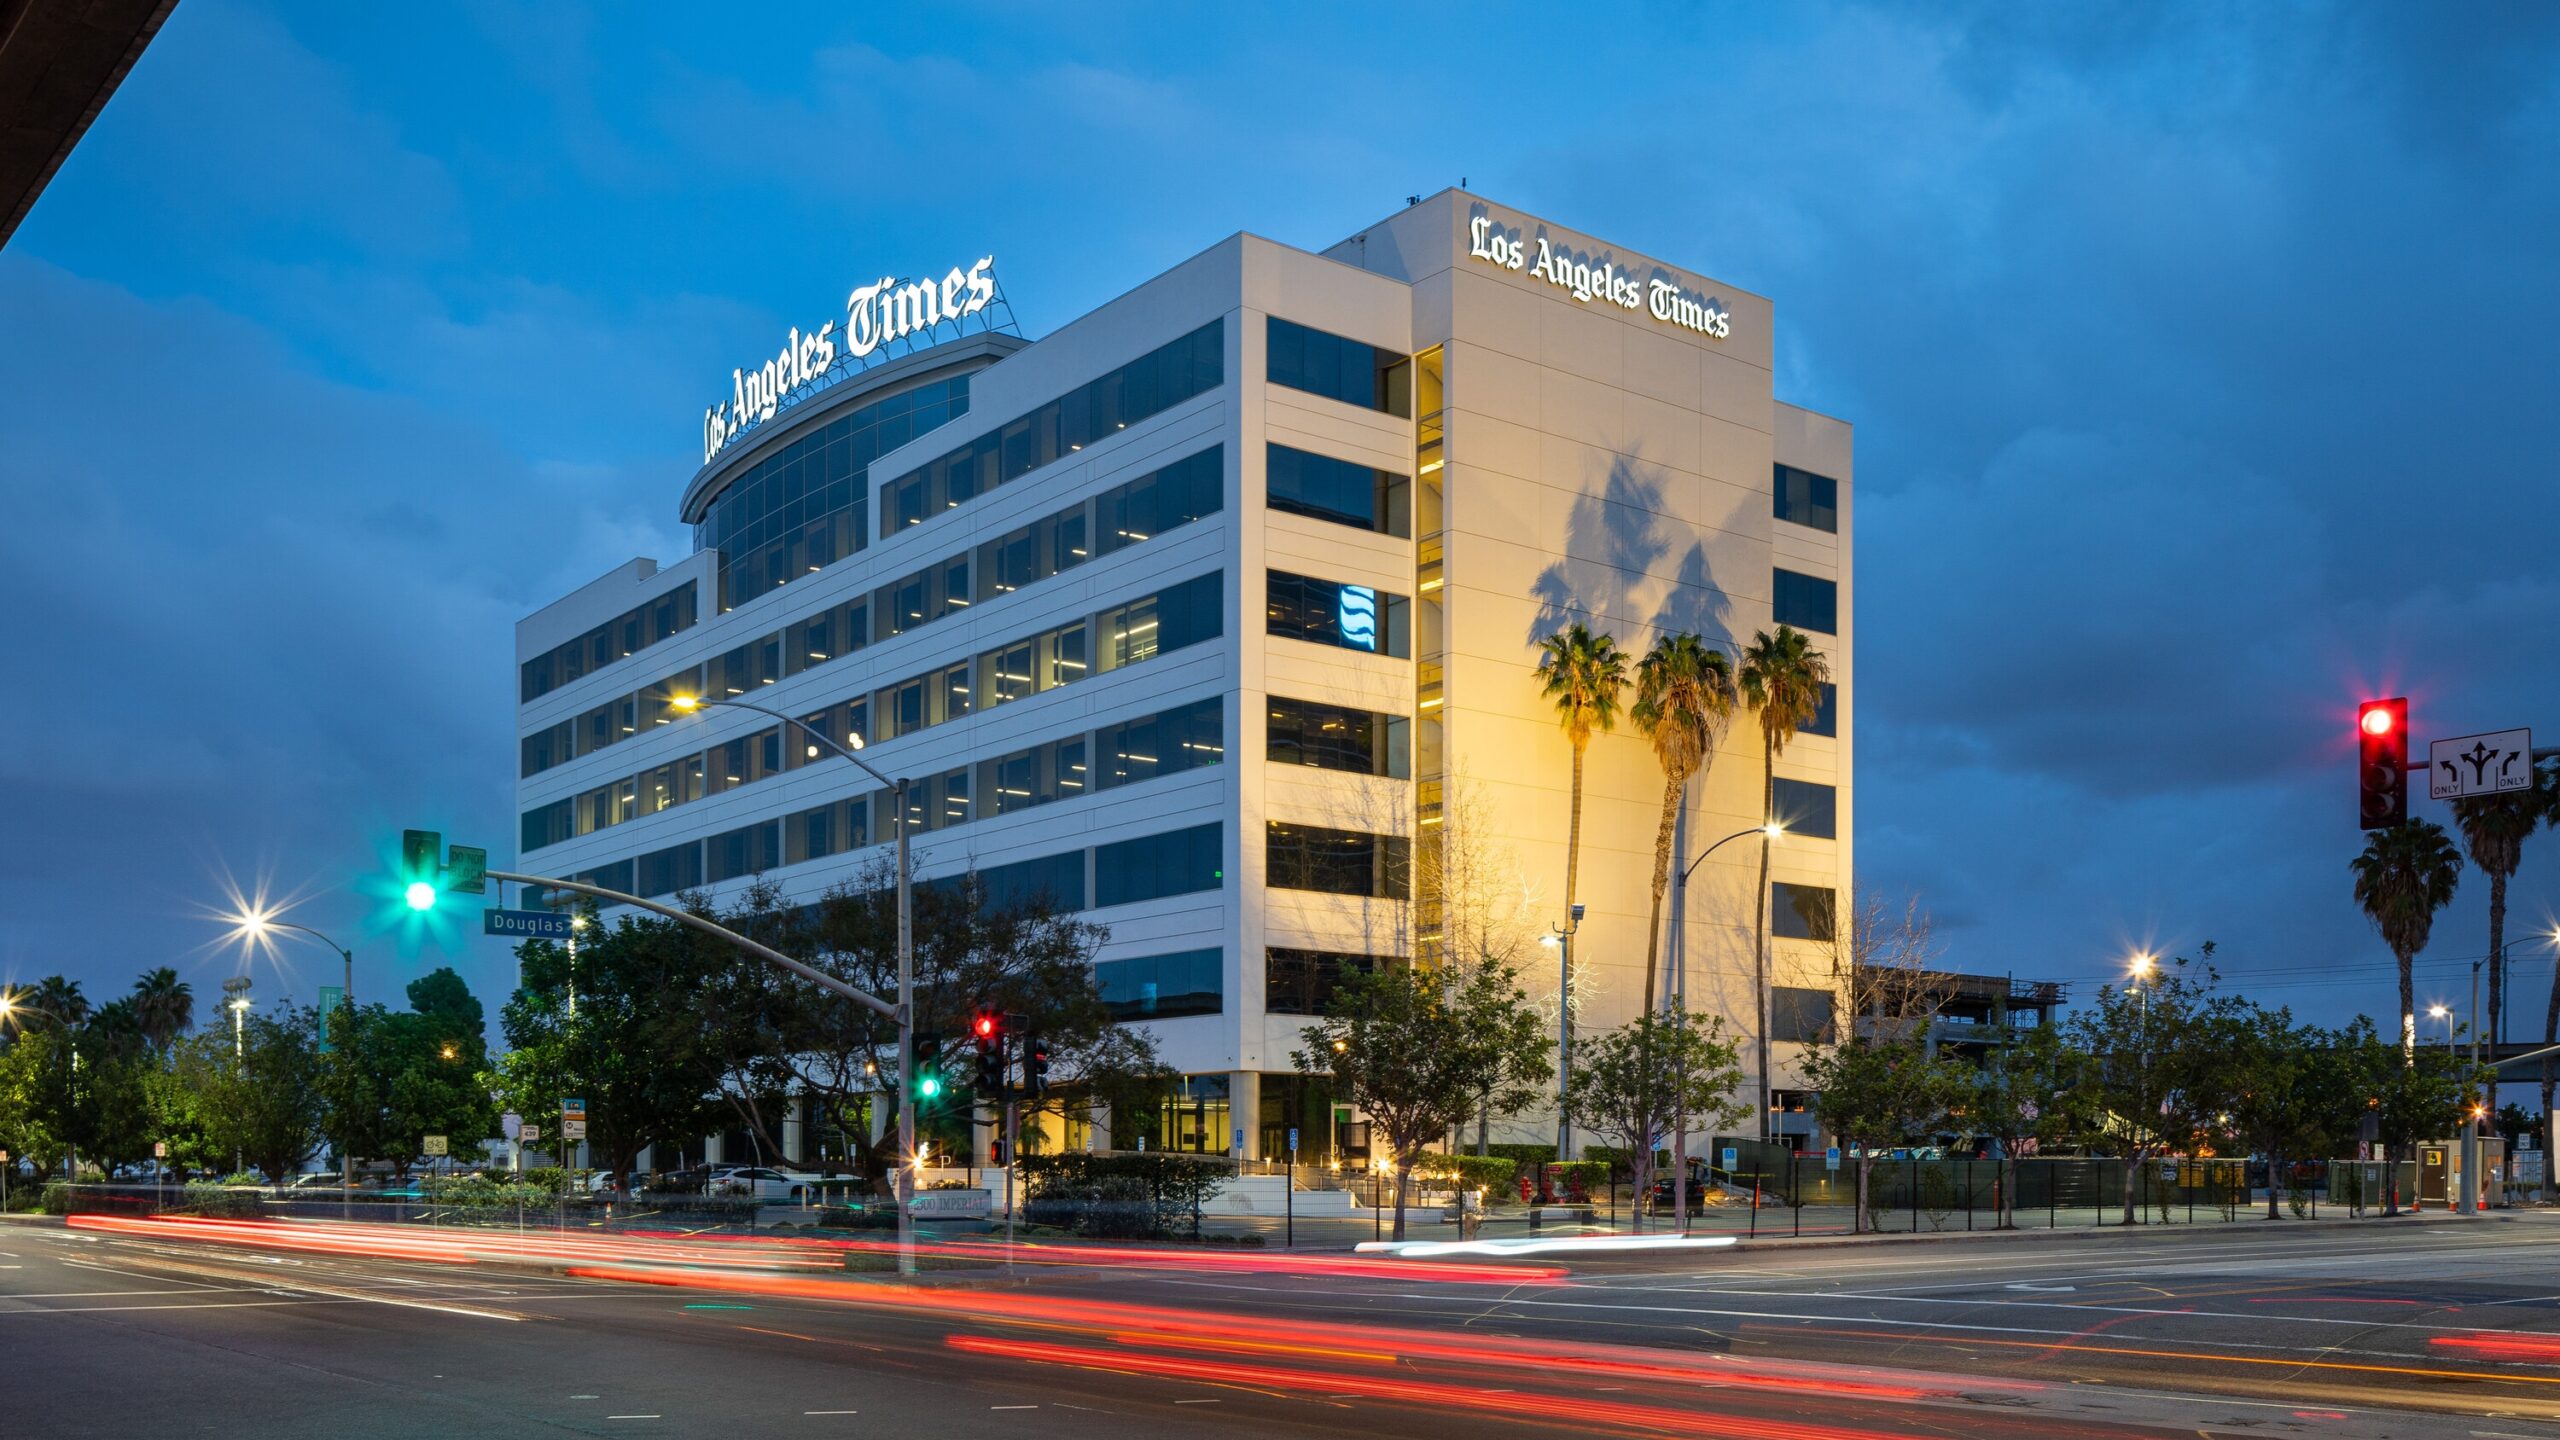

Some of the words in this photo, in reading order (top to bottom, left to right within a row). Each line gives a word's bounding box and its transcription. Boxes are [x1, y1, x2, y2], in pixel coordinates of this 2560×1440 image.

[1470, 216, 1523, 271] Los
[1529, 238, 1640, 309] Angeles
[1648, 278, 1730, 339] Times
[704, 399, 727, 465] Los
[728, 319, 836, 437] Angeles
[847, 254, 995, 357] Times
[2434, 784, 2459, 795] ONLY
[2499, 776, 2525, 788] ONLY
[451, 851, 463, 863] DO
[467, 853, 484, 866] NOT
[494, 914, 564, 935] Douglas
[940, 1197, 985, 1211] IMPERIAL
